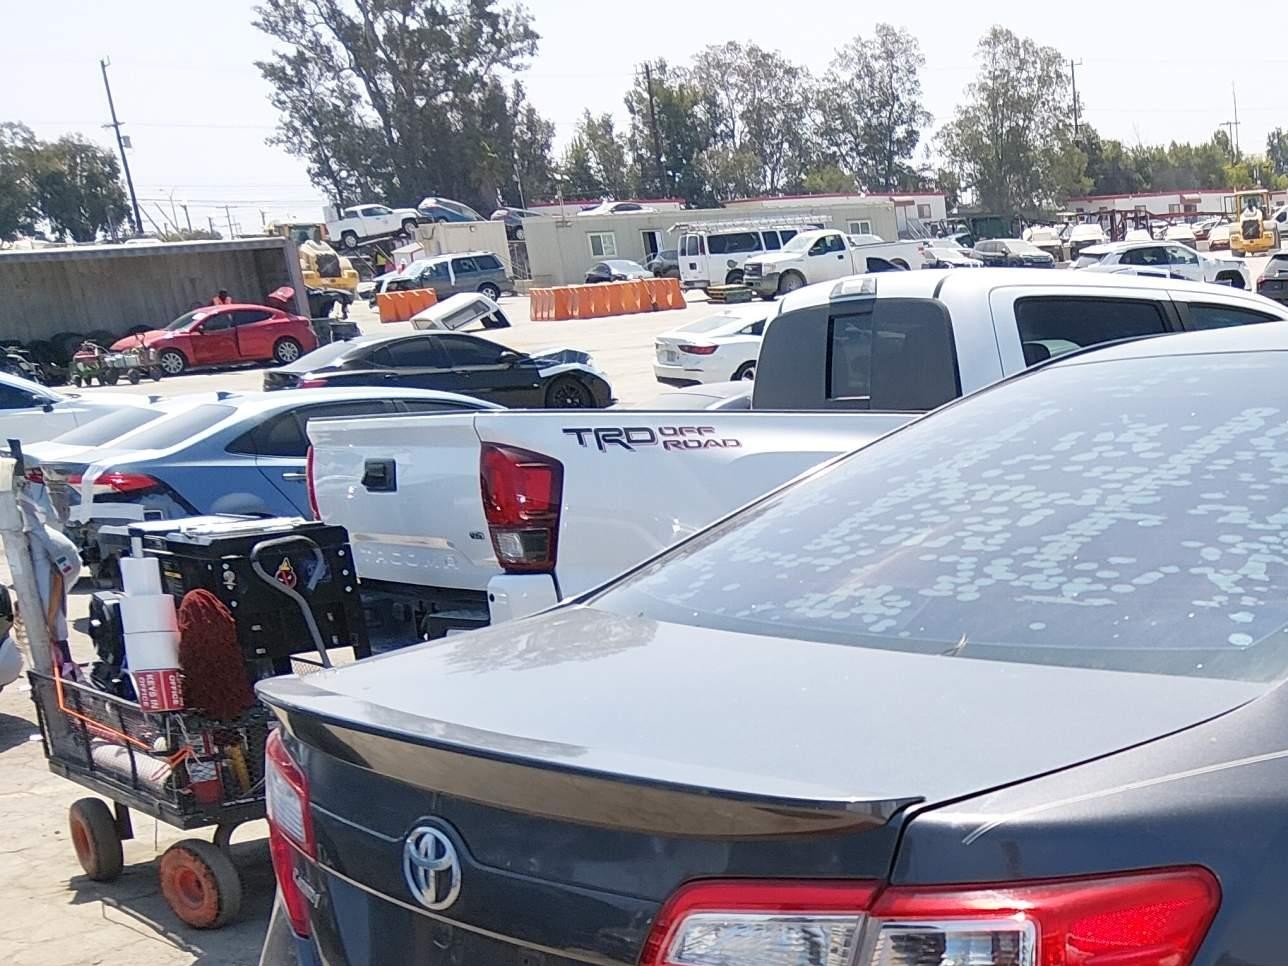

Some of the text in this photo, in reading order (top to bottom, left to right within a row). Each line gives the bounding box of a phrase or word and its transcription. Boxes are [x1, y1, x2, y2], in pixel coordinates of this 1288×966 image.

[562, 427, 658, 452] TRD
[658, 426, 716, 437] OFF
[663, 439, 743, 451] ROAD
[359, 549, 459, 570] TACOMA
